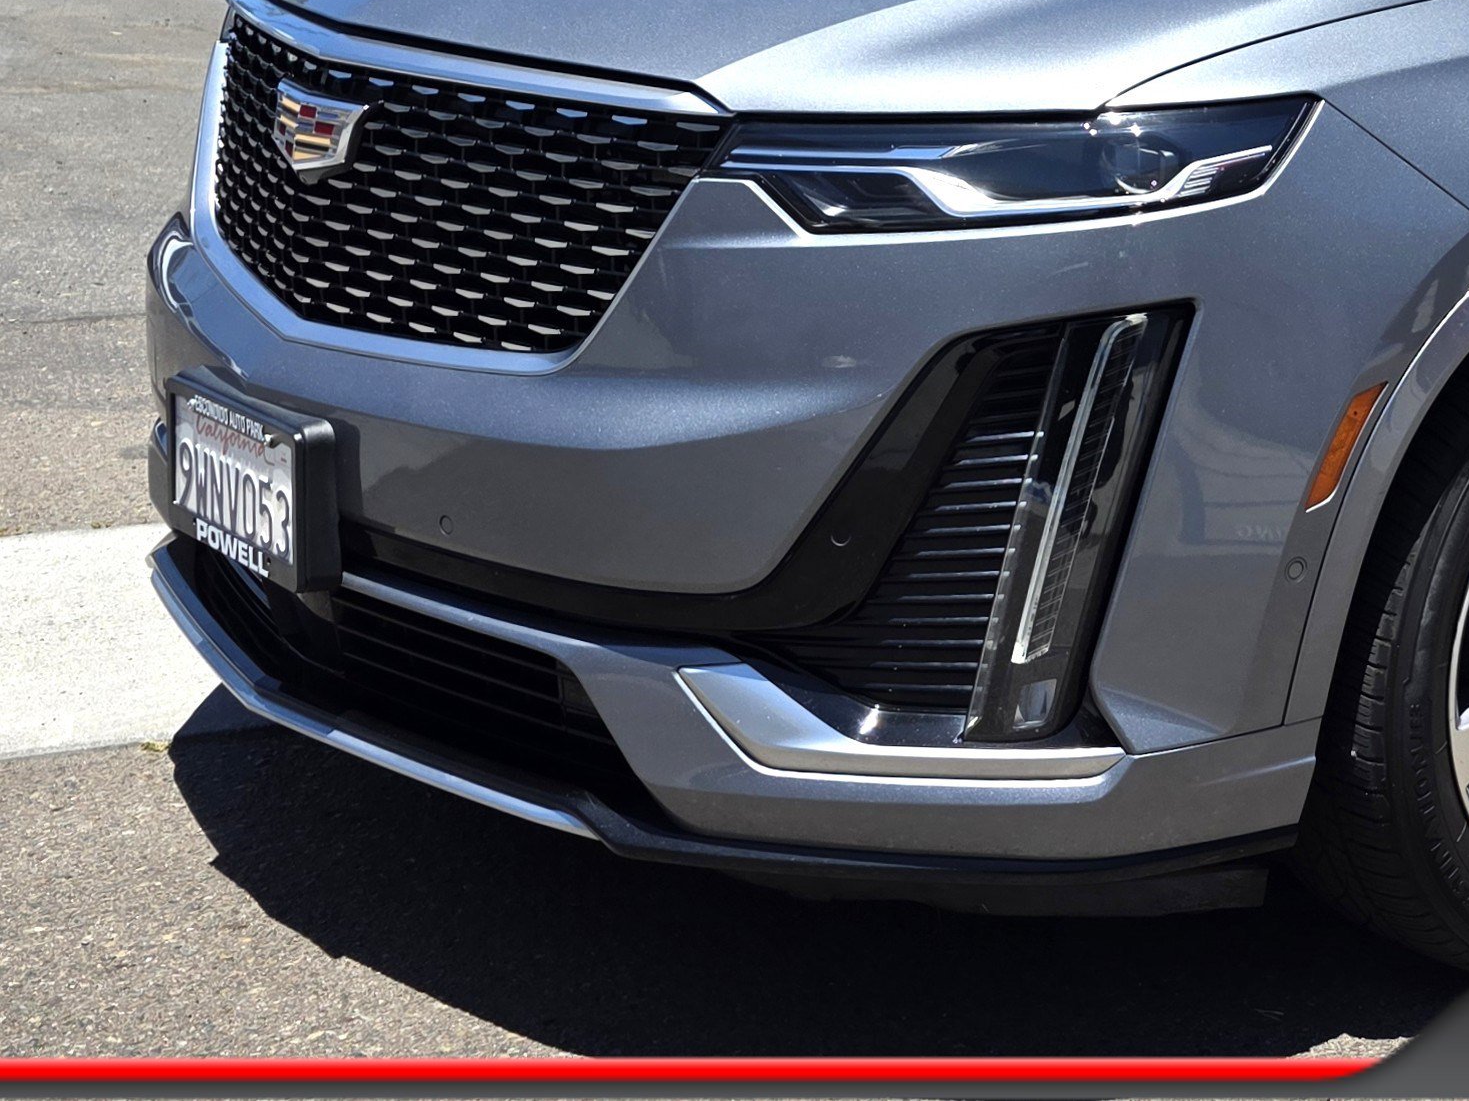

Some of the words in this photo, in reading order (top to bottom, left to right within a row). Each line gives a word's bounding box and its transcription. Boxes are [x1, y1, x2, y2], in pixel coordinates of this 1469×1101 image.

[229, 410, 246, 434] AUTO
[246, 417, 265, 442] PARK
[179, 441, 291, 560] 9WNV053
[195, 518, 270, 578] POWELL
